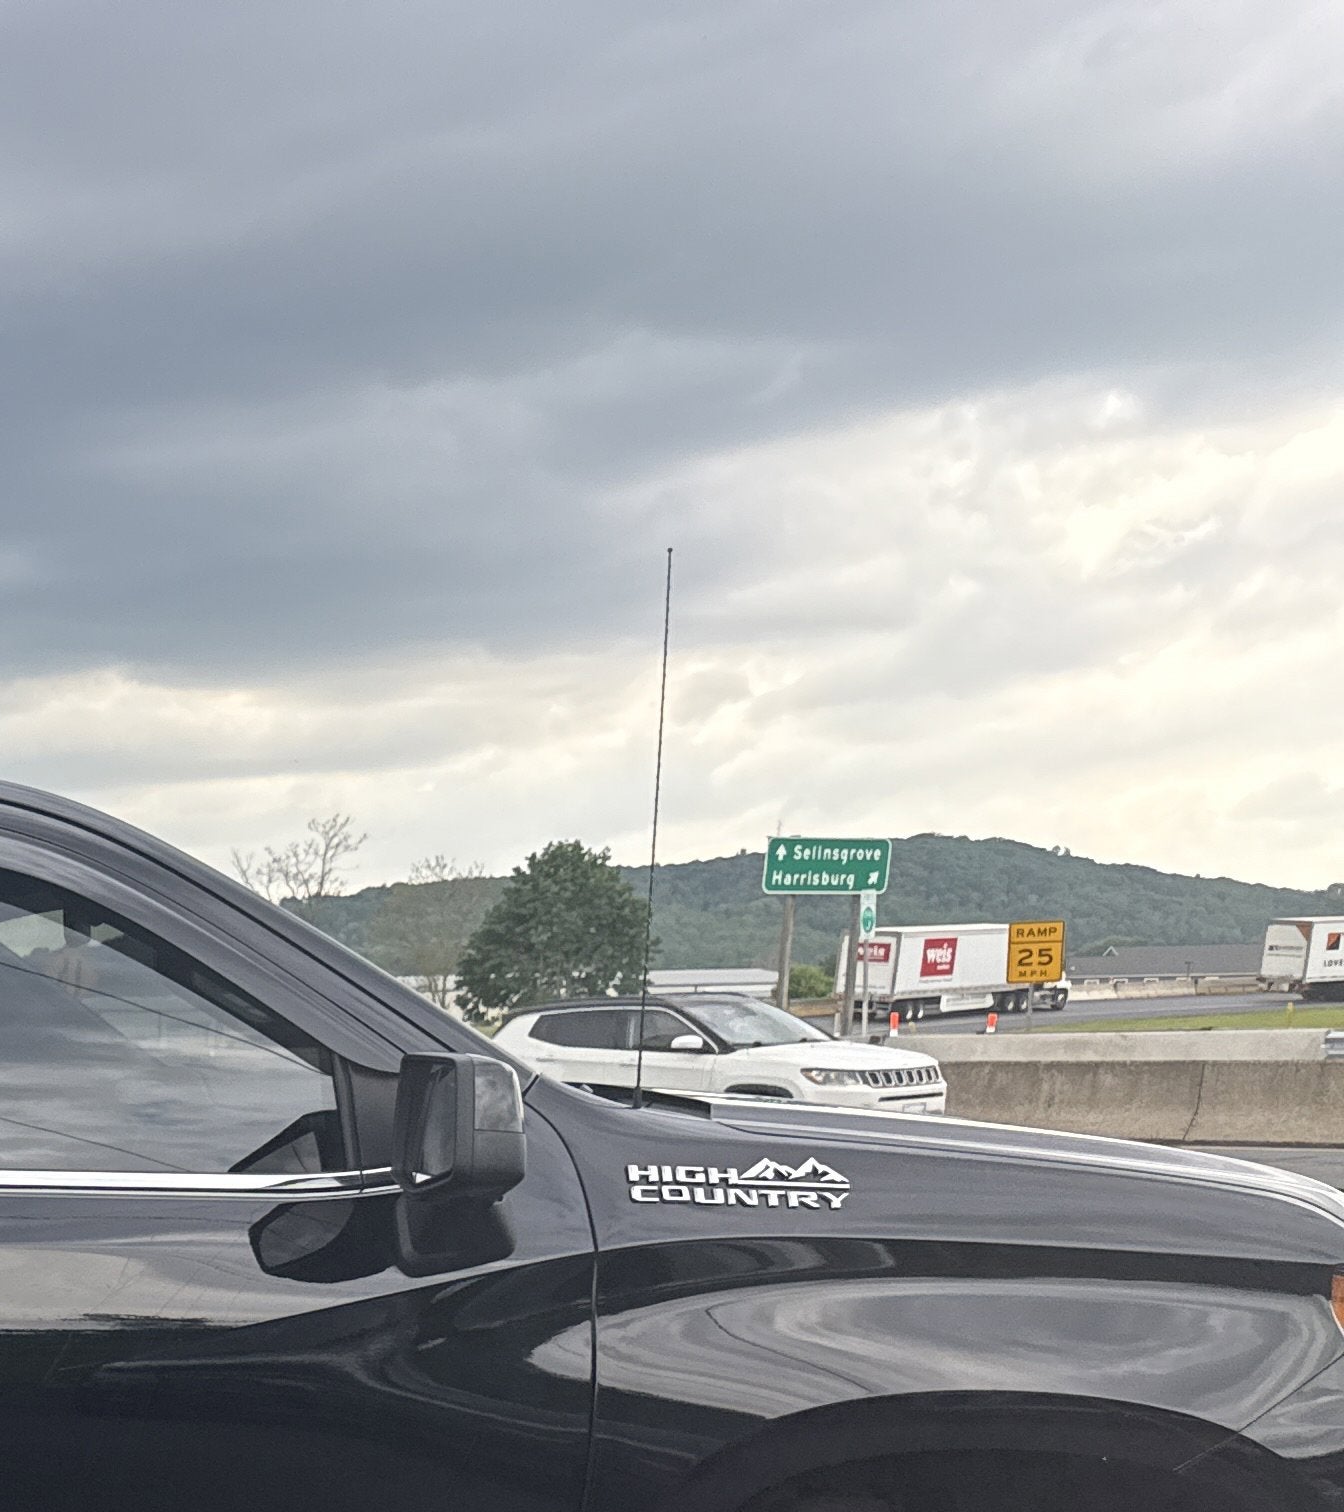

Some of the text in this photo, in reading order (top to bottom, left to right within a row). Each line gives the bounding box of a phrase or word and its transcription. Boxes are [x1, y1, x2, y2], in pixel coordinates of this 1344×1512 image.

[793, 844, 882, 866] Selinsgrove
[771, 870, 855, 890] Harrisburg
[1016, 926, 1058, 938] RAMP
[1017, 948, 1053, 967] 25
[627, 1164, 739, 1185] HIGH
[630, 1185, 850, 1210] COUNTRY
